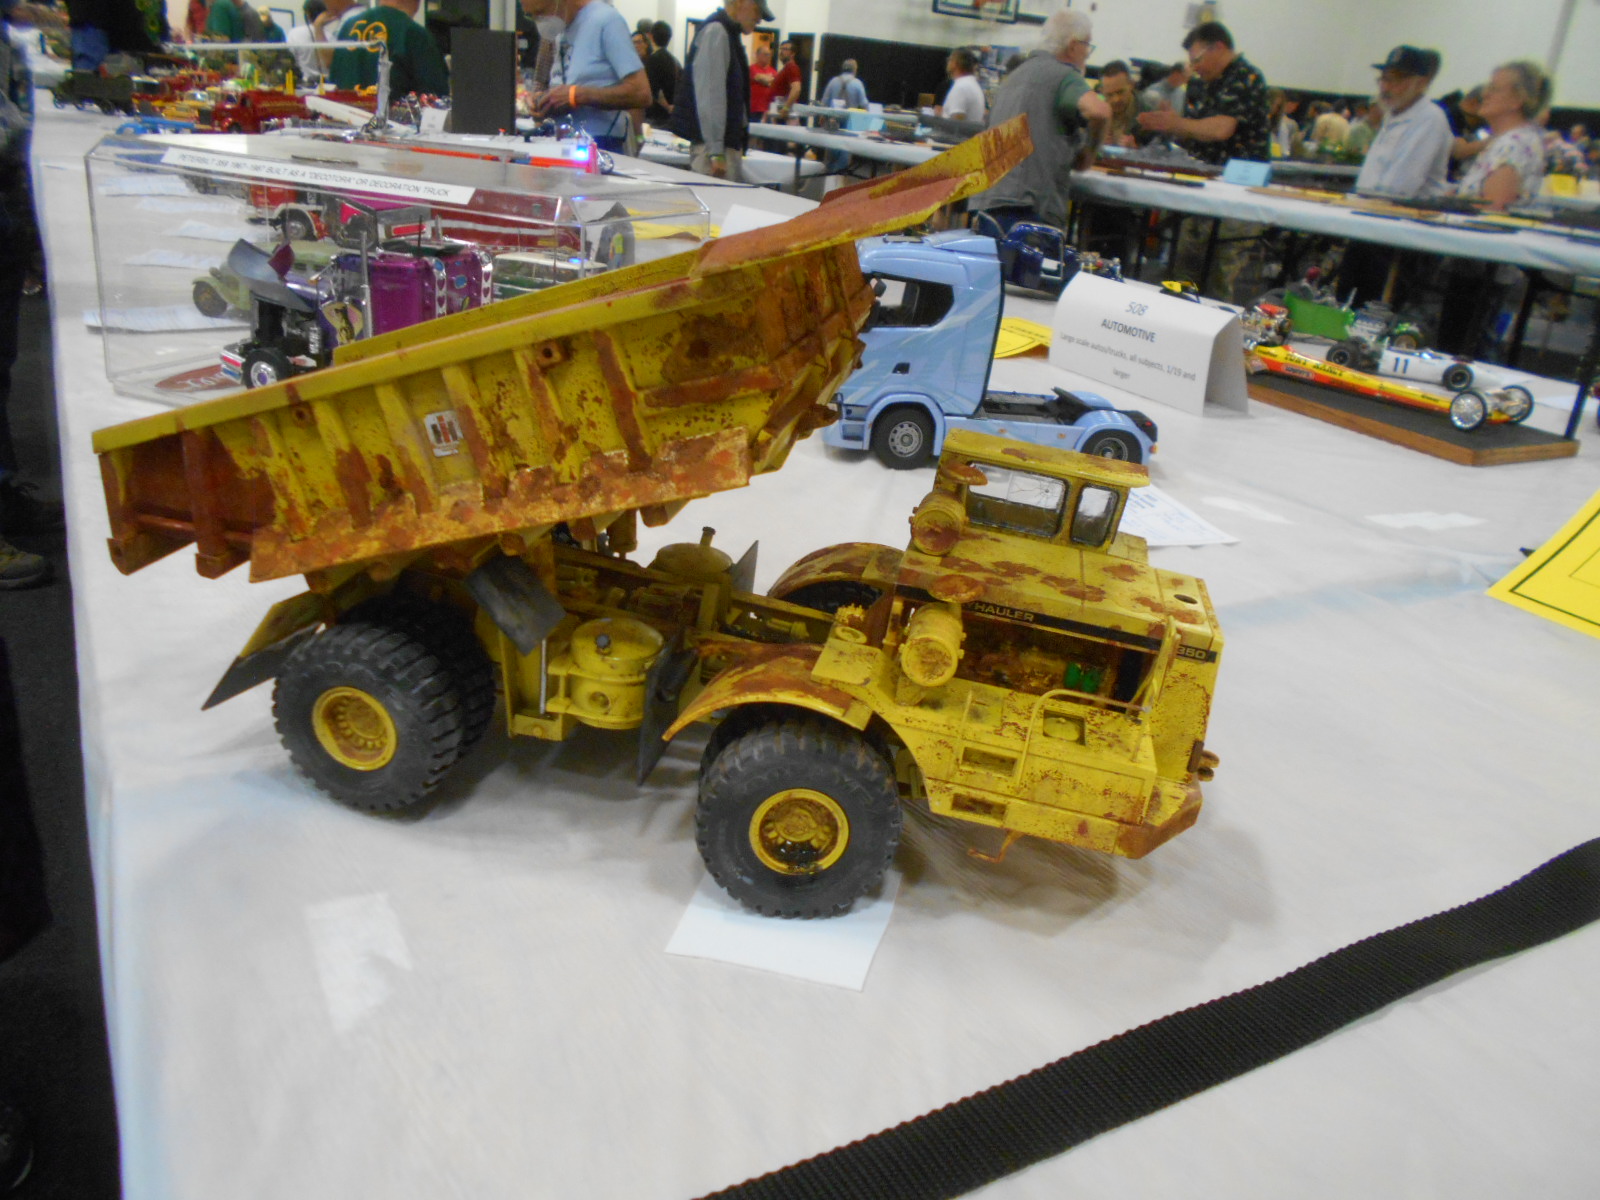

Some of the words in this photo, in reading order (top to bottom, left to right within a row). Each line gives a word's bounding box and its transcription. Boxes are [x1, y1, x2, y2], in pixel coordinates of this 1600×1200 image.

[369, 178, 420, 194] DECORATION
[423, 186, 450, 198] TRUCK
[1125, 301, 1149, 317] 508
[1101, 318, 1157, 343] AUTOMOTIVE
[1060, 332, 1076, 345] Large
[1075, 336, 1091, 348] scale
[1129, 352, 1138, 363] all
[1183, 371, 1197, 382] and
[1392, 356, 1411, 375] 11
[1112, 367, 1131, 381] larger
